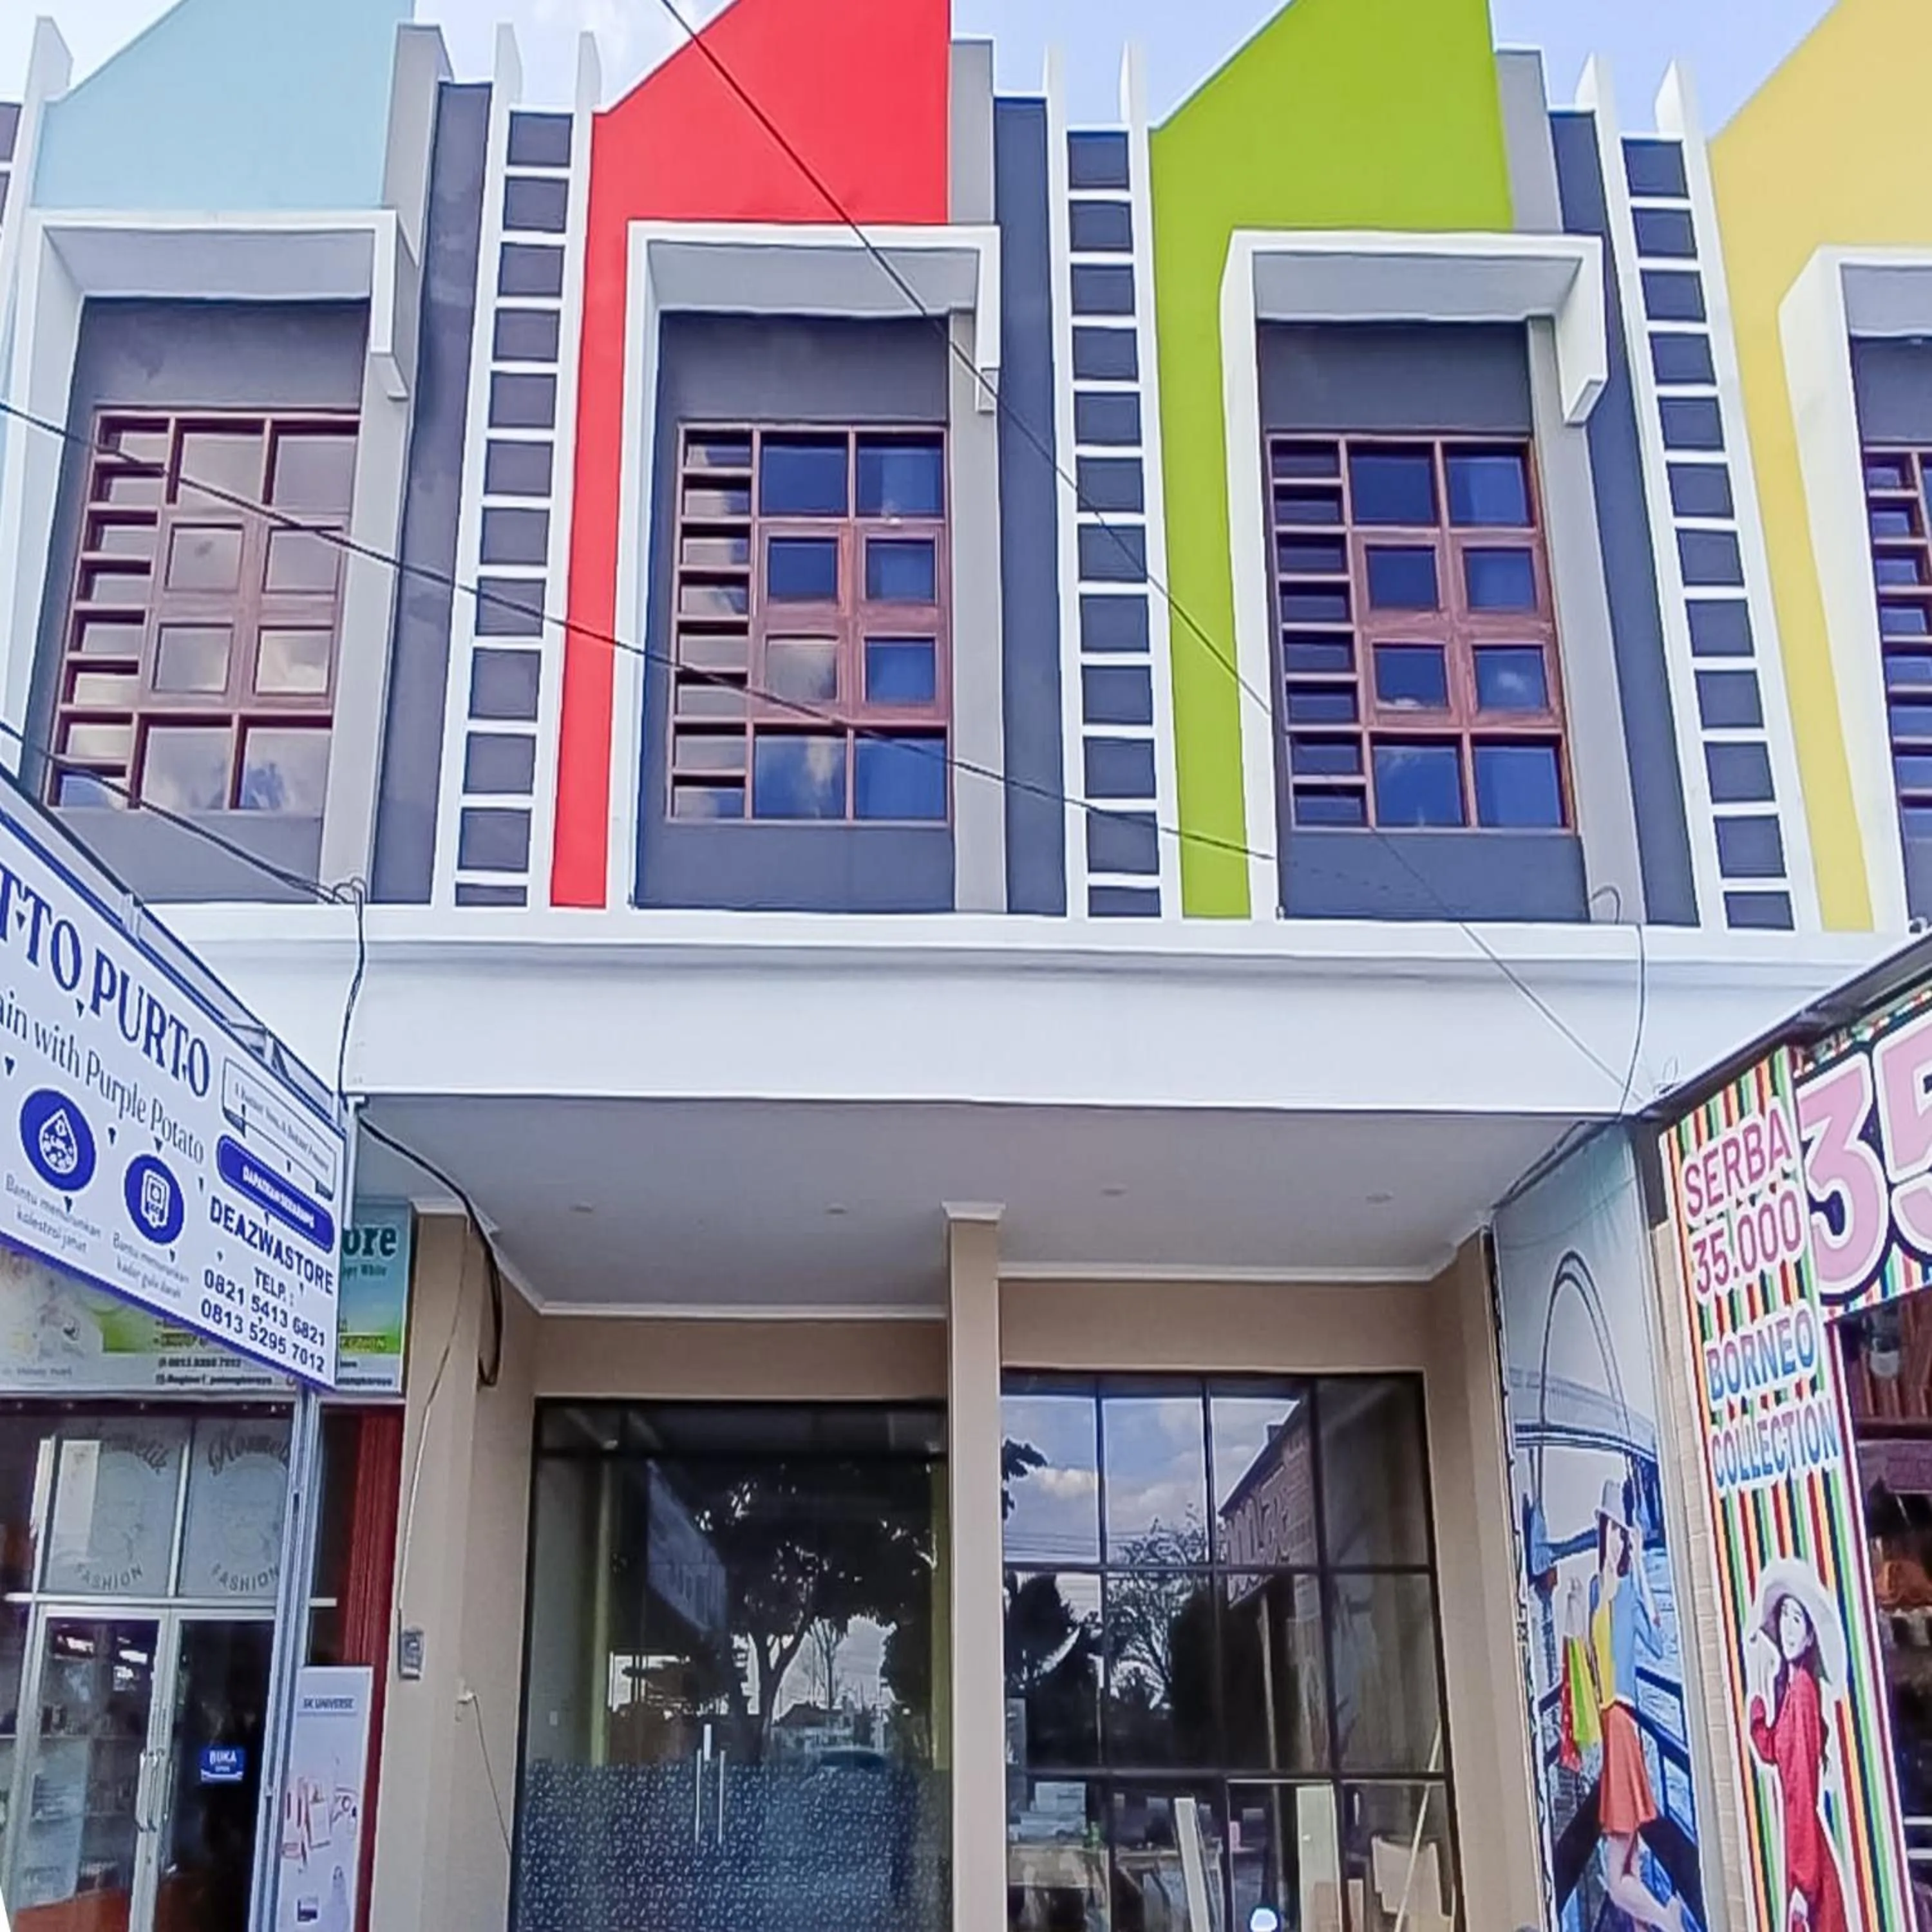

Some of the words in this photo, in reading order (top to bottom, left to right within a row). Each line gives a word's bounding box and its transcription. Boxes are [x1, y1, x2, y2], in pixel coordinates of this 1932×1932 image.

[90, 947, 211, 1097] PURTO
[34, 1021, 80, 1079] with
[86, 1050, 147, 1123] Purple
[150, 1097, 205, 1165] Potato
[1684, 1108, 1792, 1217] SERBA
[210, 1195, 334, 1294] DEAZWASTORE
[1692, 1190, 1801, 1294] 35.000
[201, 1298, 243, 1334] 0813
[249, 1322, 287, 1355] 5295
[292, 1343, 325, 1374] 7012
[204, 1269, 244, 1307] 0821
[251, 1294, 289, 1329] 5413
[292, 1316, 325, 1347] 6821
[1707, 1309, 1815, 1402] BORNEO
[1711, 1399, 1839, 1488] COLLECTION
